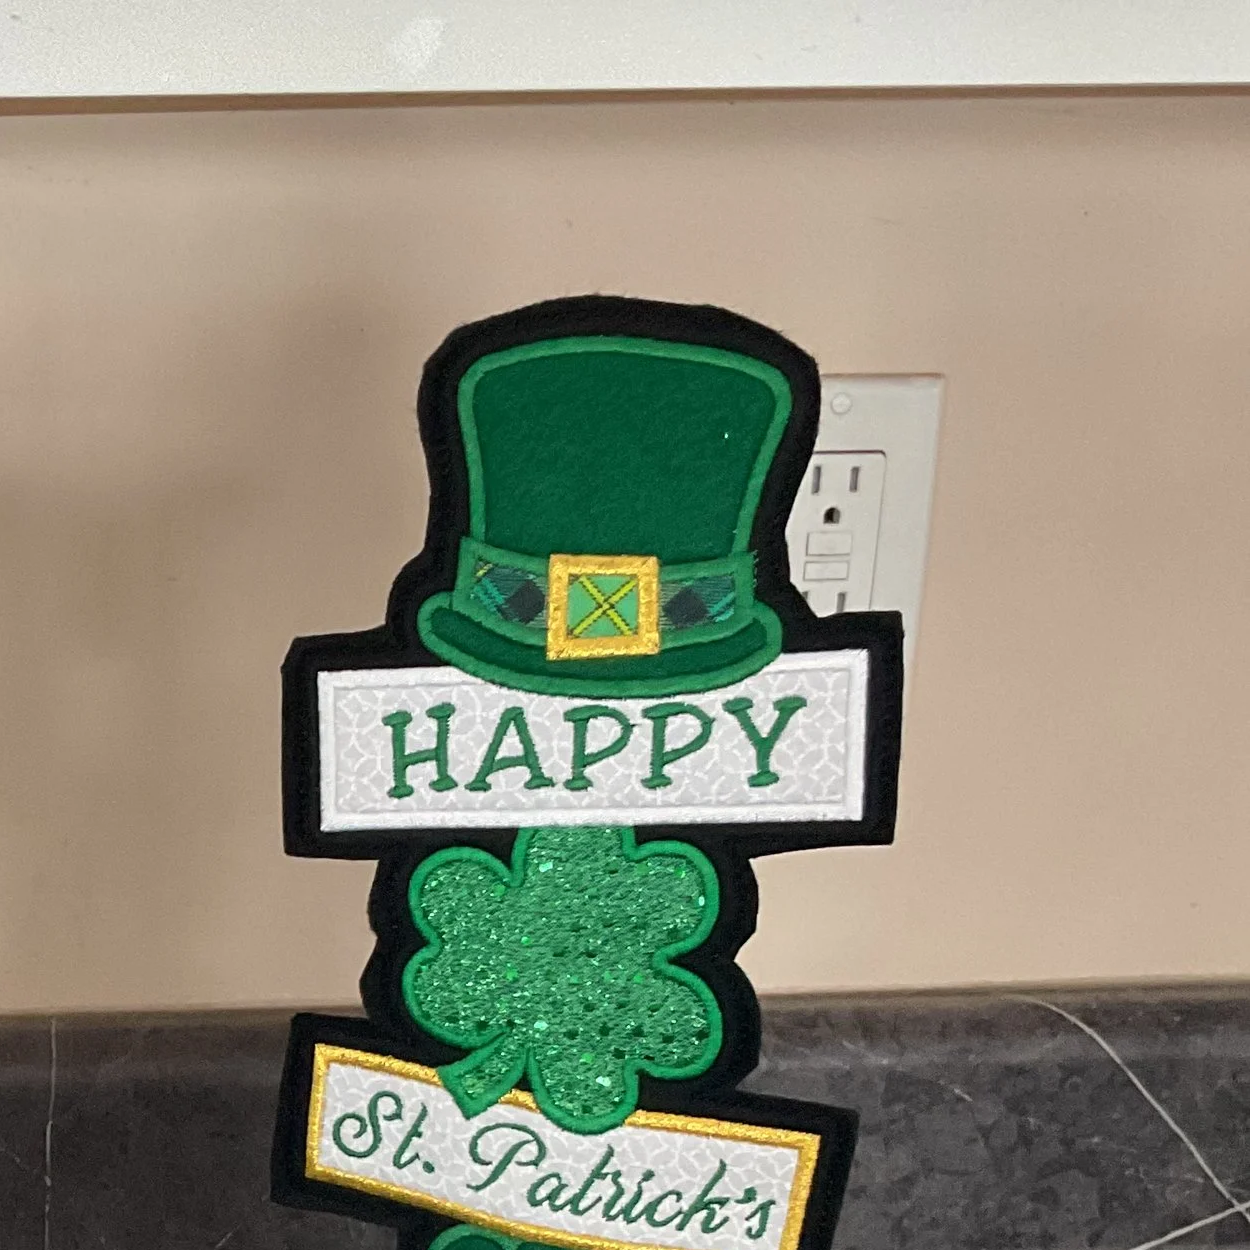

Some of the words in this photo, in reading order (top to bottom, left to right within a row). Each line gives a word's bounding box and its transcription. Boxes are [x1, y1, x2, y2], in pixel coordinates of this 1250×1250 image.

[382, 696, 807, 798] HAPPY
[332, 1091, 435, 1174] St.
[466, 1123, 777, 1241] Patrick's
